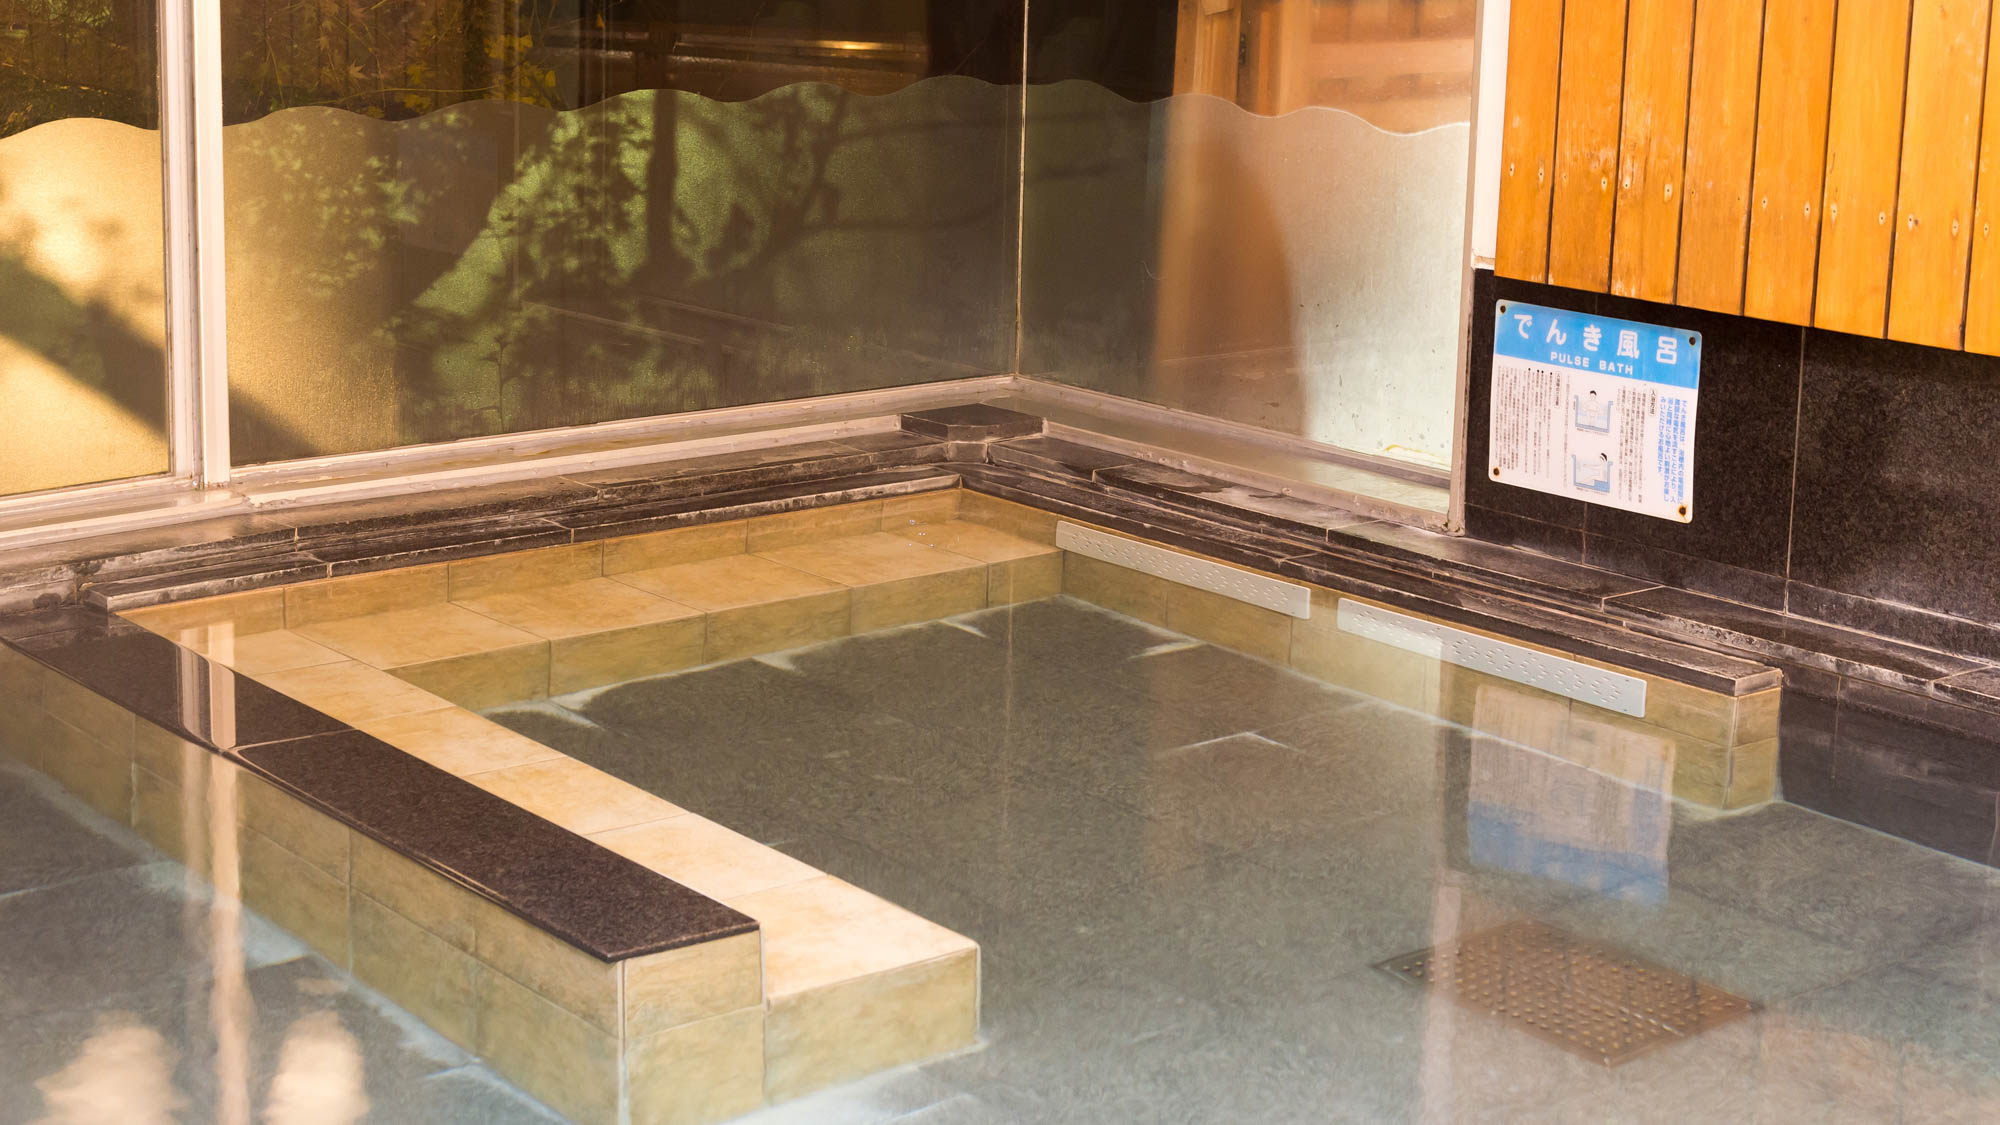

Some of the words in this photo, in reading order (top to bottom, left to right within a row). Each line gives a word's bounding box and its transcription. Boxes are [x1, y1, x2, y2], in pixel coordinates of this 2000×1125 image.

[1513, 313, 1678, 366] でんき風呂
[1550, 351, 1590, 368] PULSE
[1599, 360, 1634, 376] BATH
